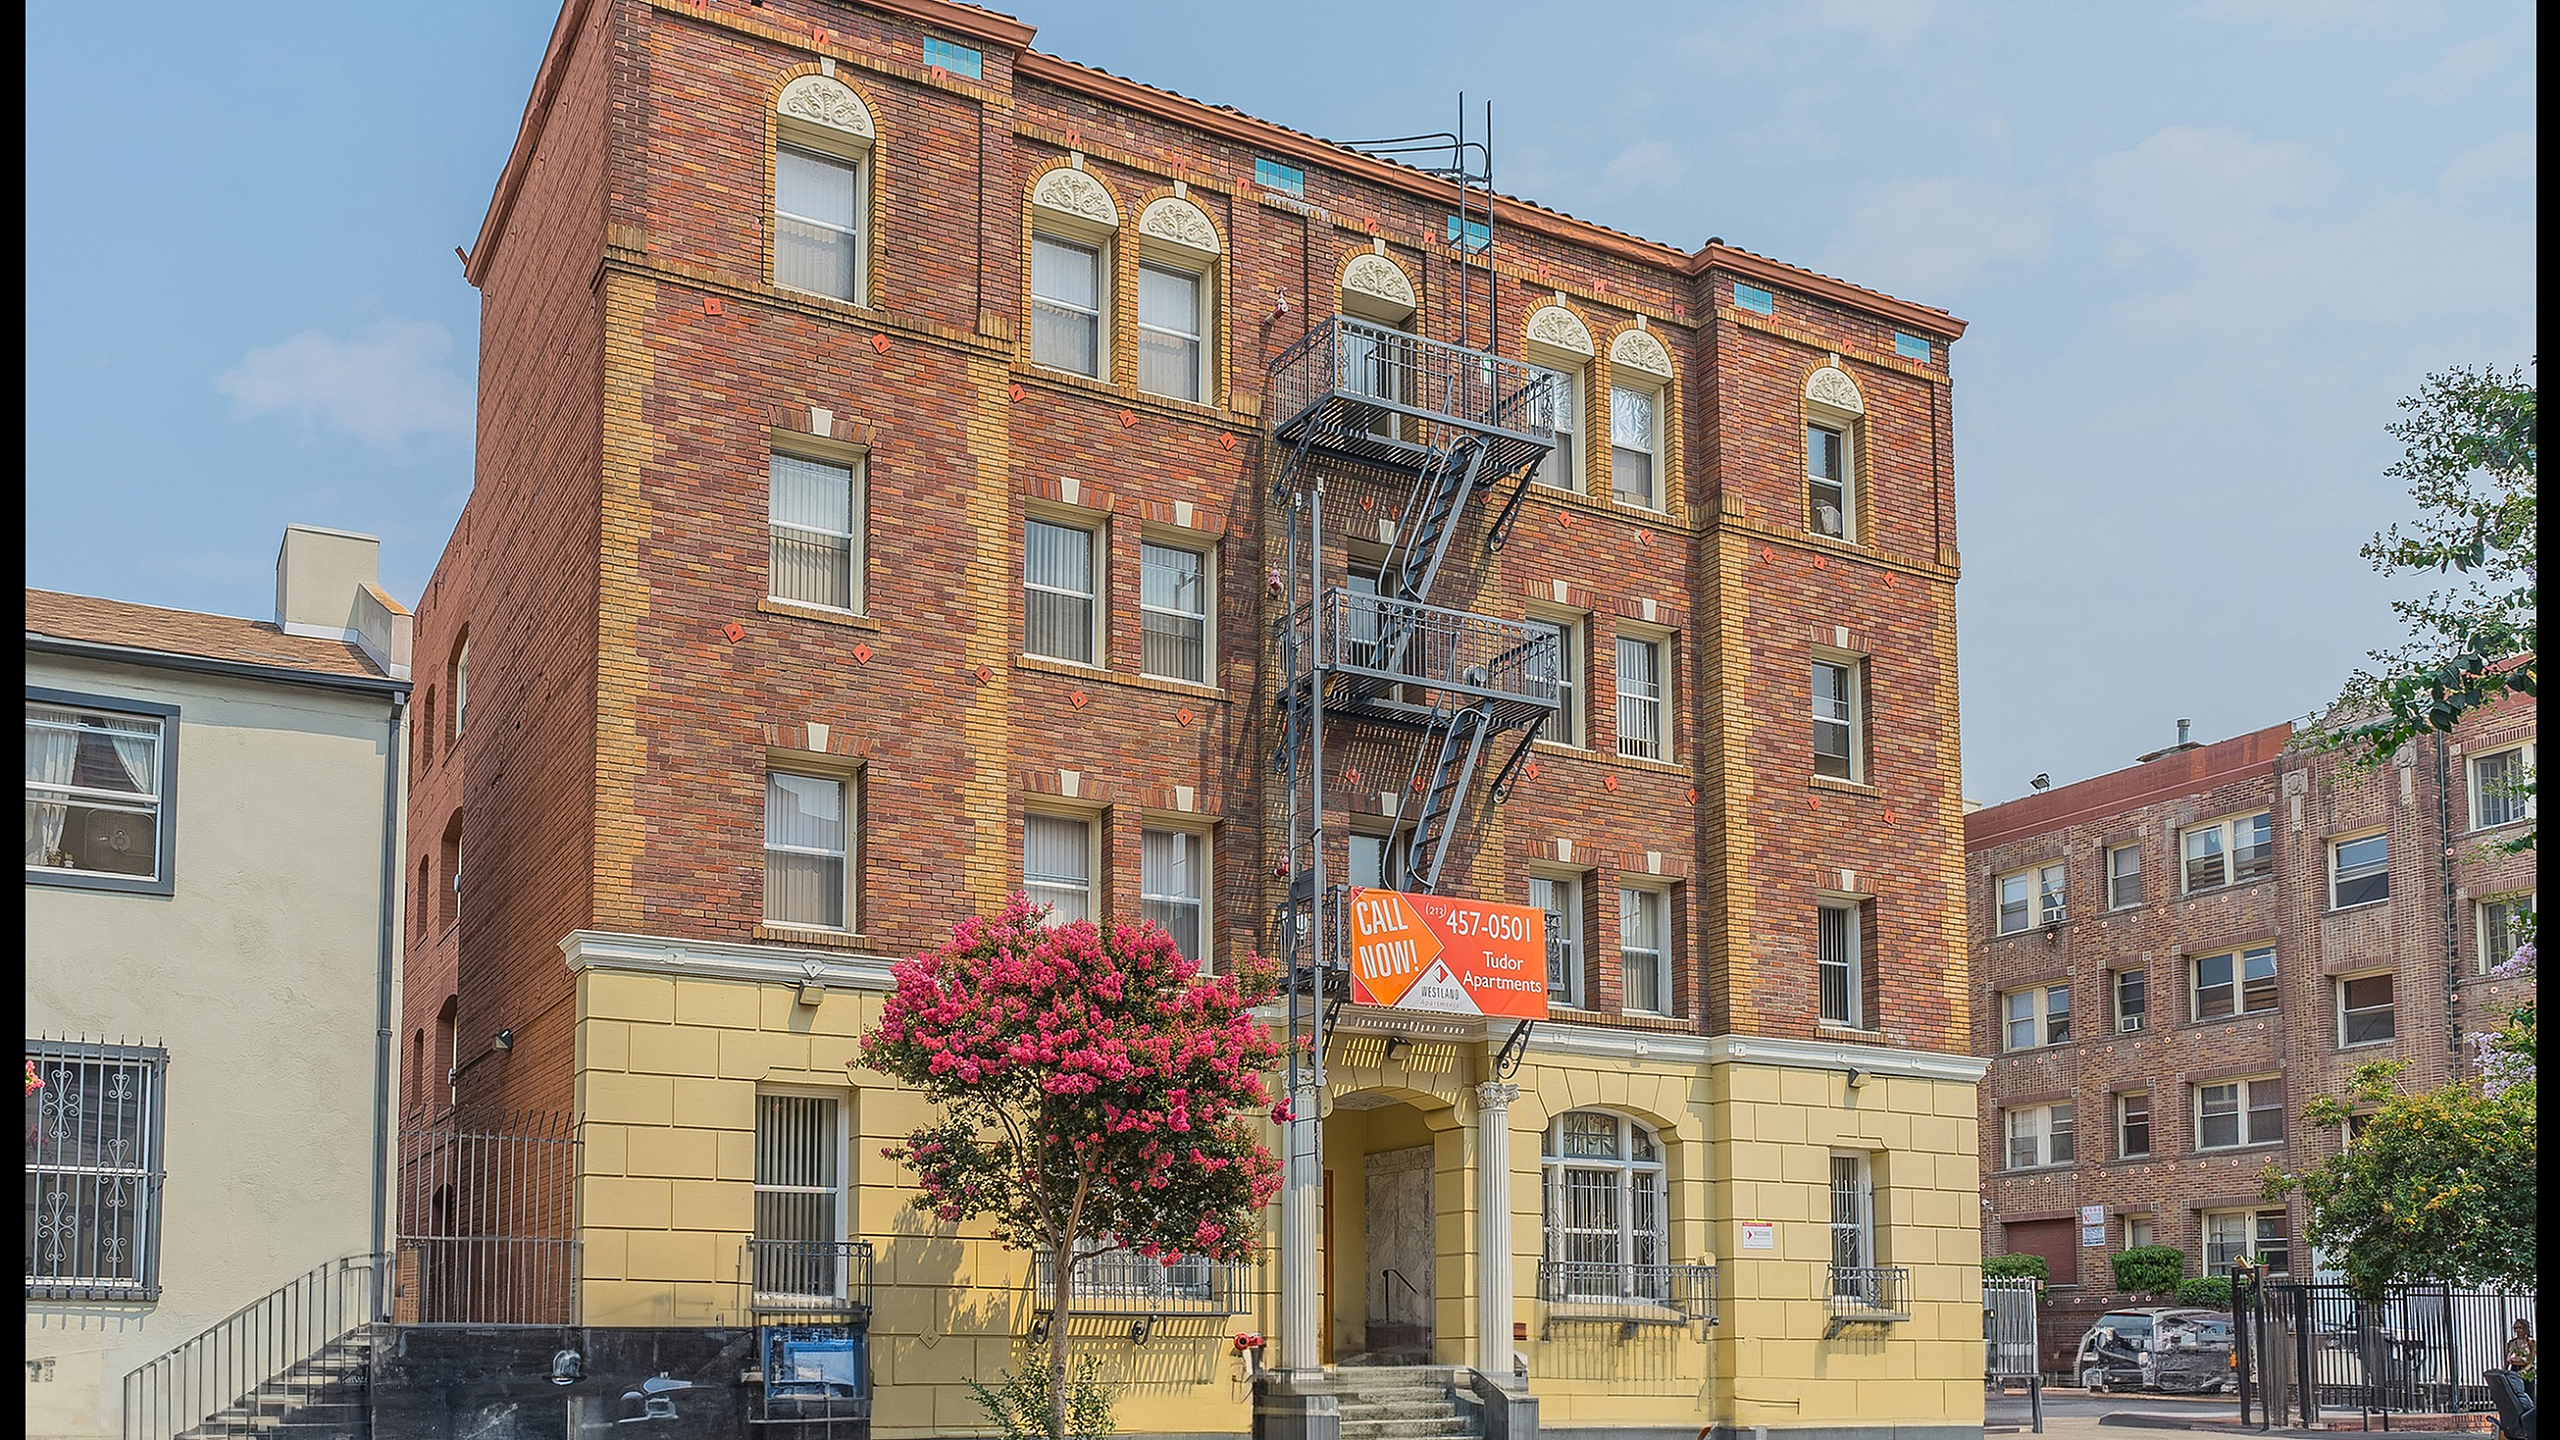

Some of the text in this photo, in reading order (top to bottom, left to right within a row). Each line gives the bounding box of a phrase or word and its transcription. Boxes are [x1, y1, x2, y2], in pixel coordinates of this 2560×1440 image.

[1356, 897, 1408, 936] CALL
[1425, 902, 1531, 942] (213) 457-0501
[1358, 939, 1419, 980] NOW!
[1482, 951, 1524, 971] Tudor
[1421, 986, 1460, 1000] WESTLAND
[1462, 970, 1542, 993] Apartments
